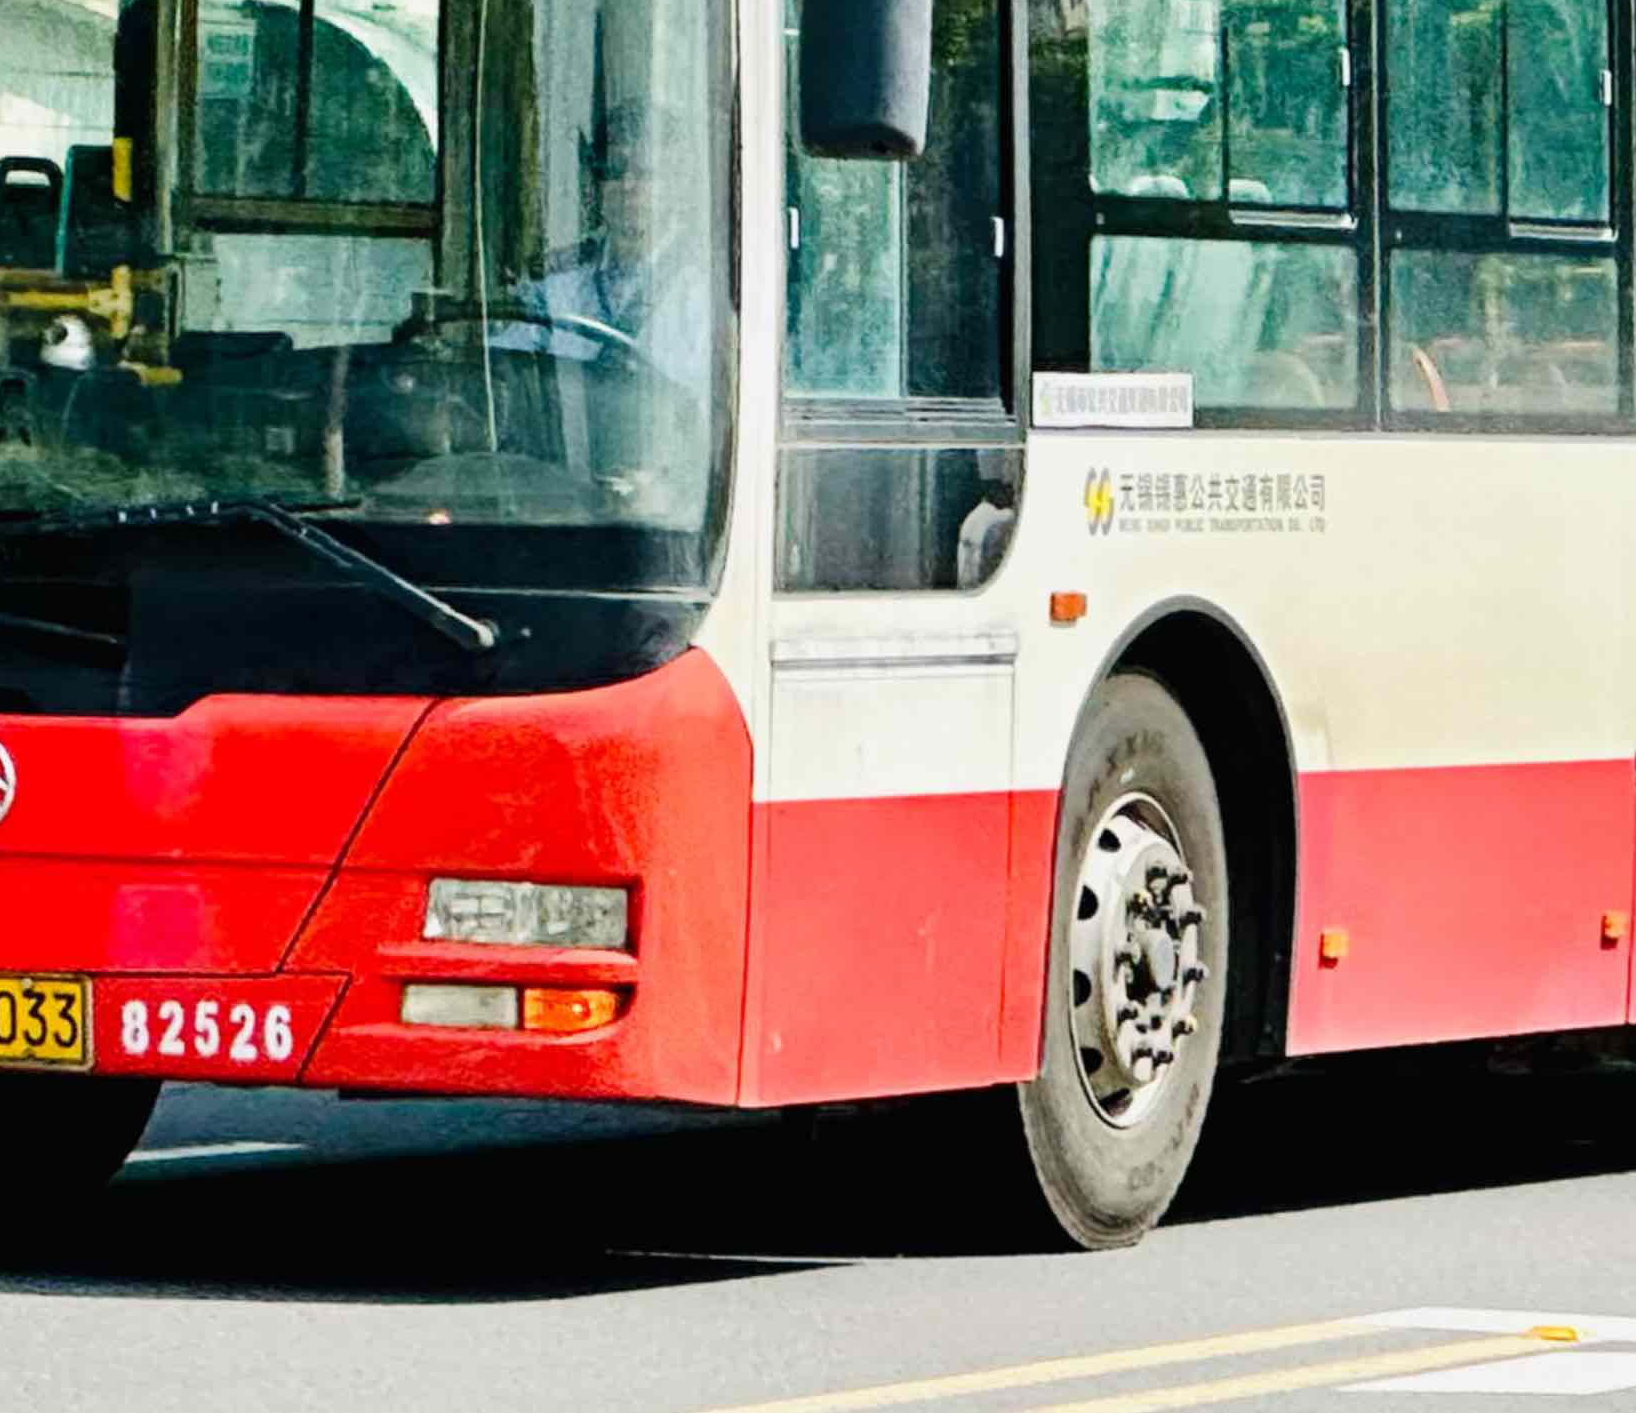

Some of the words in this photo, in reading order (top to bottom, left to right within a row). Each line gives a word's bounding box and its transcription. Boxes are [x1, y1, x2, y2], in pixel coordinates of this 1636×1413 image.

[1119, 473, 1325, 512] 无锡锡惠公共交通有限公司
[121, 999, 295, 1062] 82526
